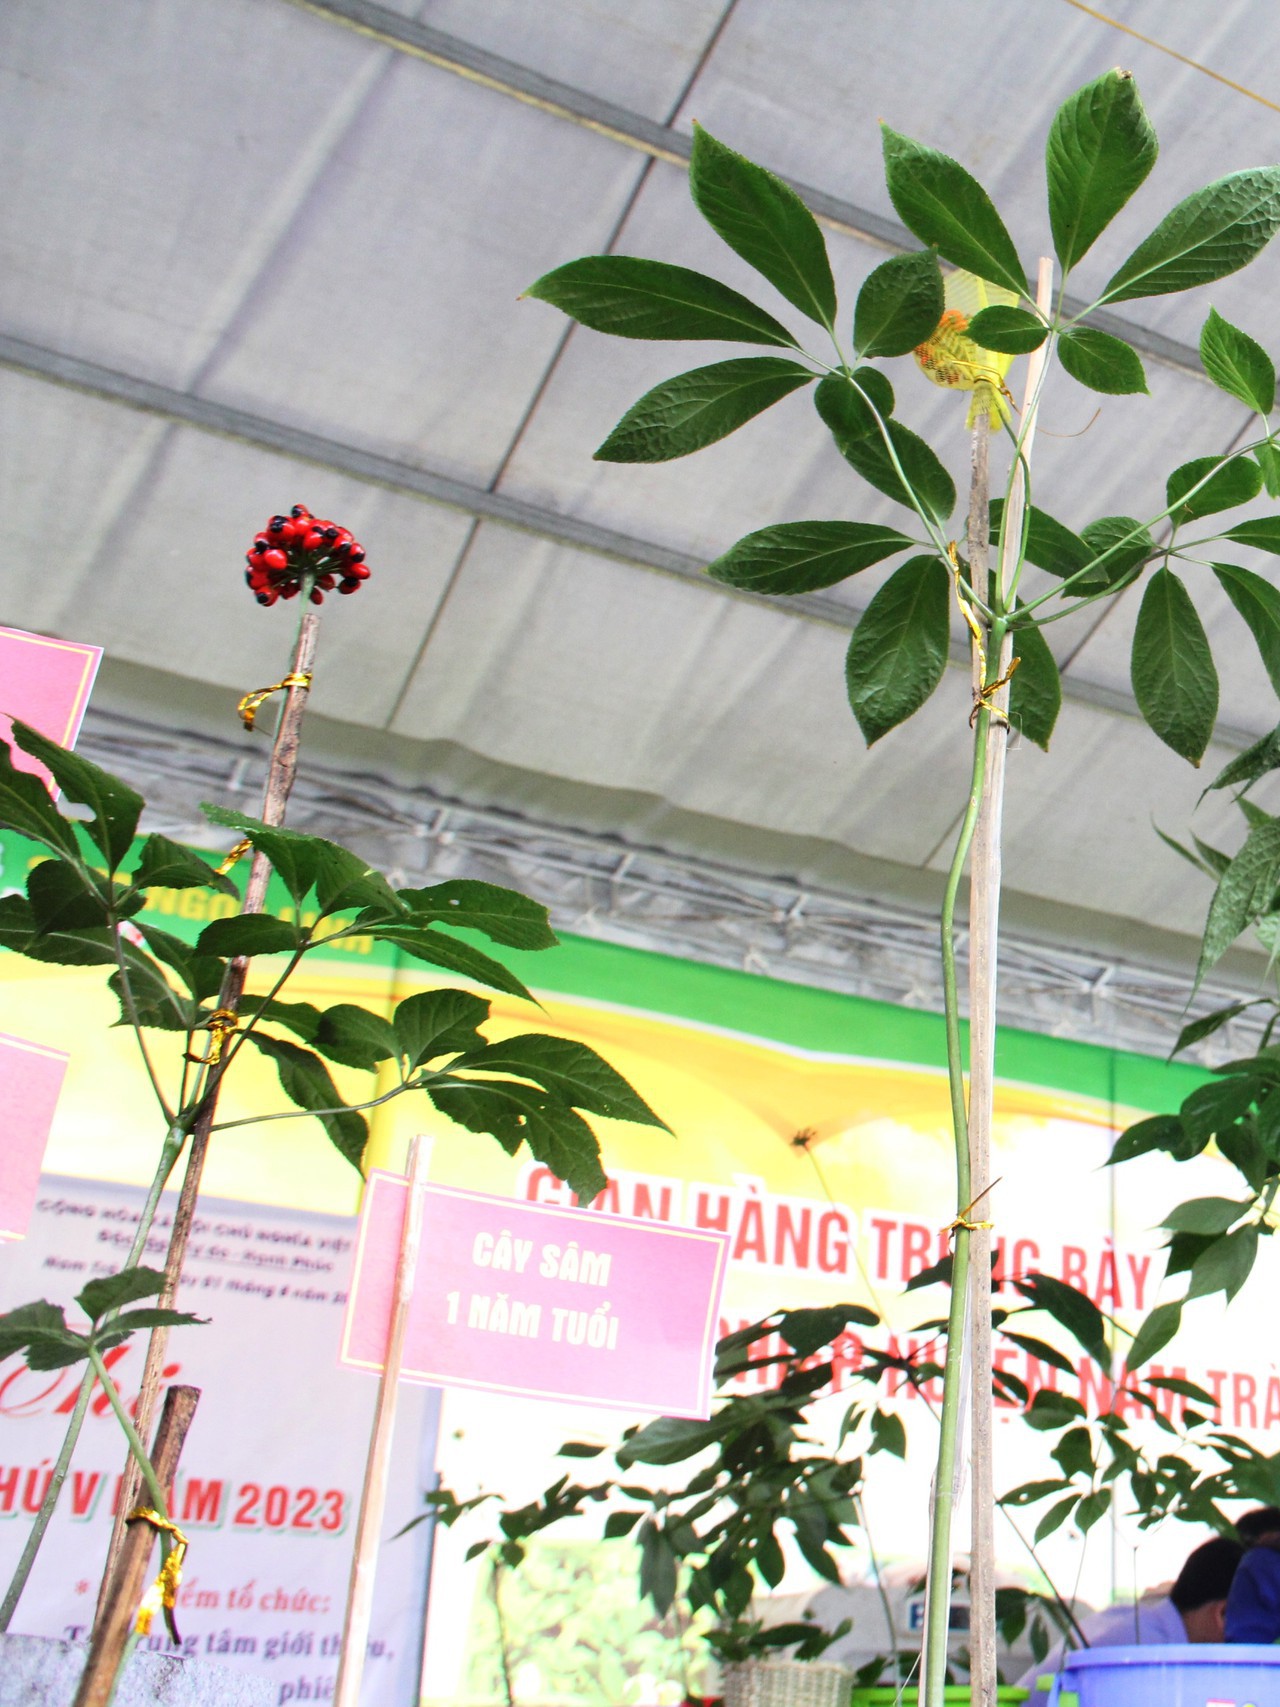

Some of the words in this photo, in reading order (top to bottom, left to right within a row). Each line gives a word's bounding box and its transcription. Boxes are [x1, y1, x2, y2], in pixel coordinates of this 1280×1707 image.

[472, 1229, 533, 1274] CÂY
[539, 1241, 612, 1287] SÂM
[696, 1184, 850, 1275] HÀNG
[1062, 1237, 1151, 1310] BÀY
[446, 1291, 460, 1325] 1
[467, 1292, 542, 1338] NĂM
[551, 1301, 620, 1350] TUỔI
[1078, 1357, 1187, 1420] NAM
[71, 1471, 101, 1515] V
[233, 1482, 347, 1532] 2023
[259, 1584, 331, 1615] chức:
[206, 1628, 258, 1655] tâm
[263, 1630, 314, 1660] giới
